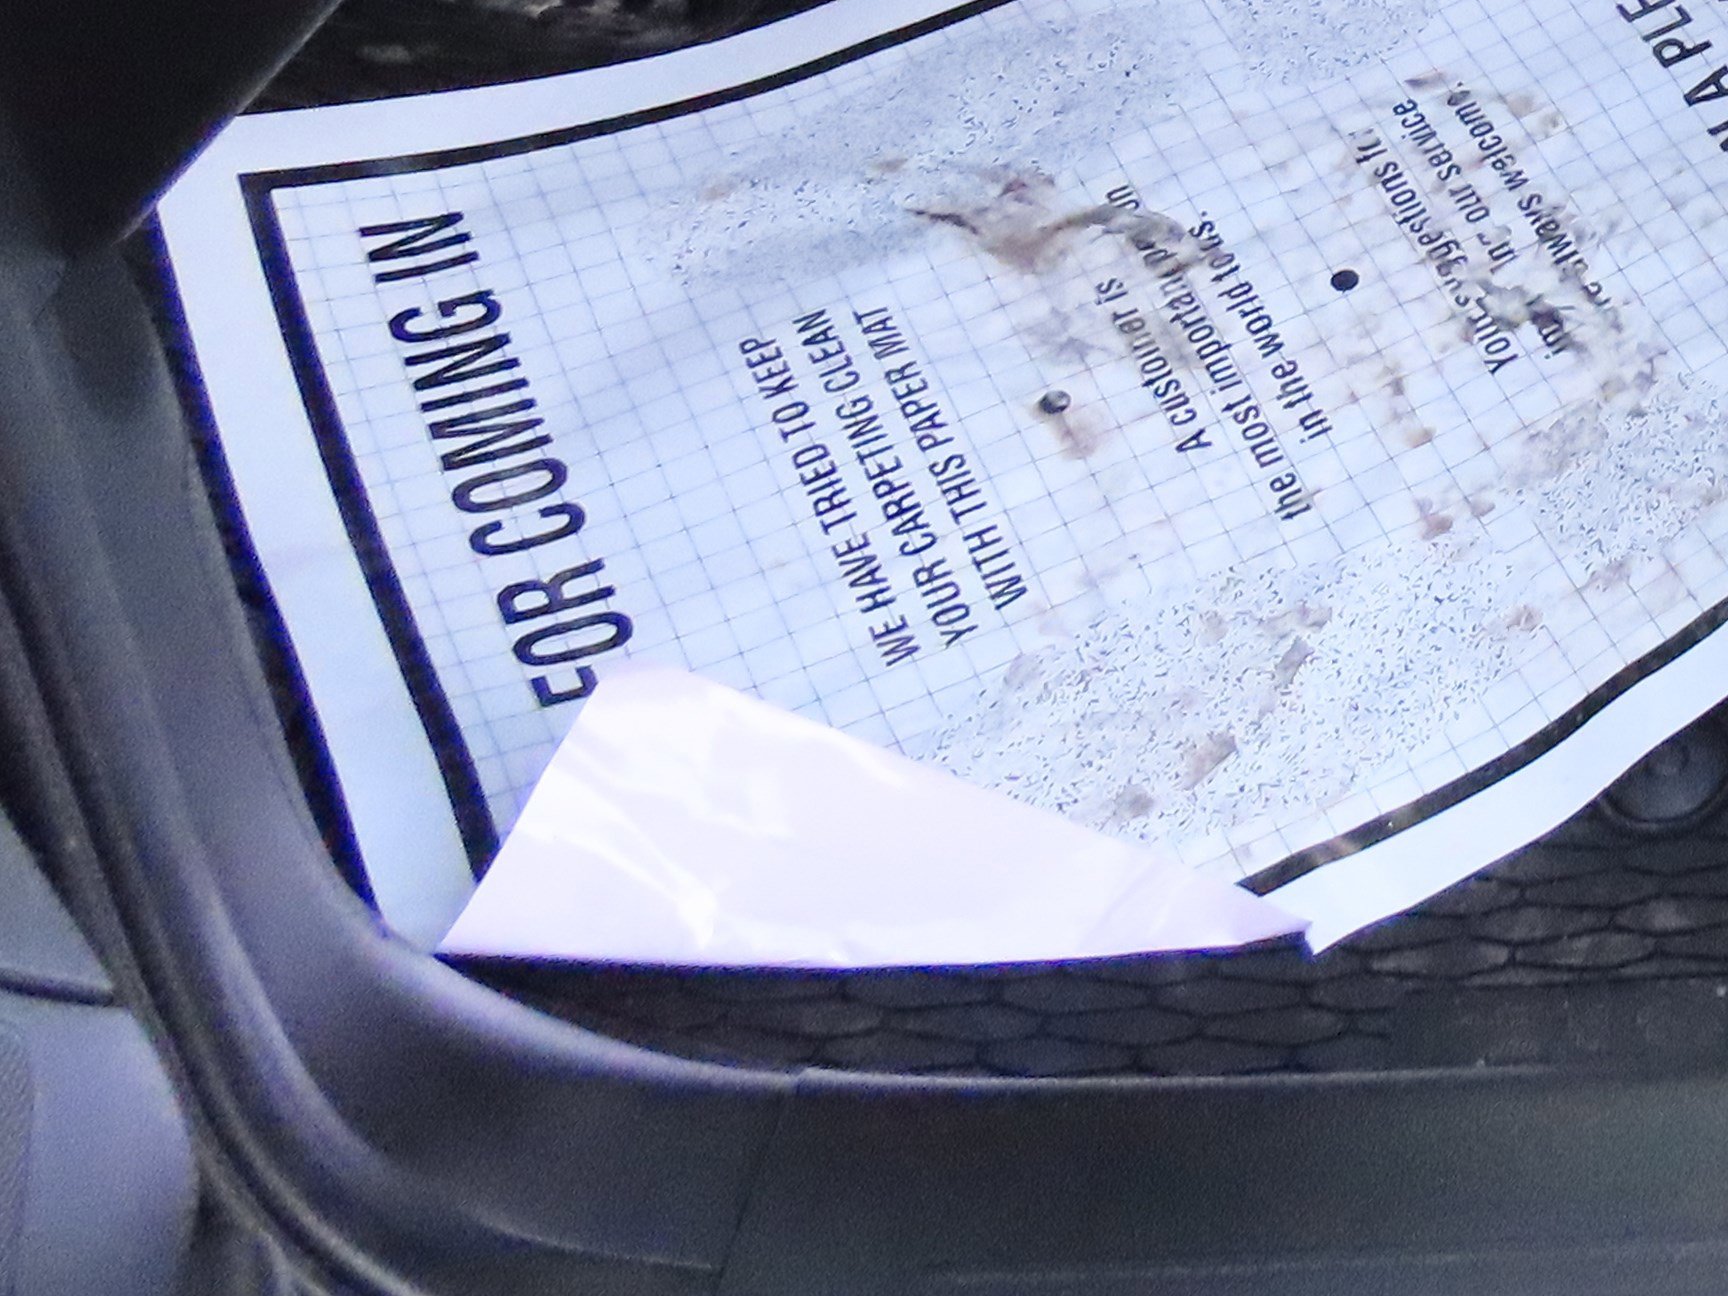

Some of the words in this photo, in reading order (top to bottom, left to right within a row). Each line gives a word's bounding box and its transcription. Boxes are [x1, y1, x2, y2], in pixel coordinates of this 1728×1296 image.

[1393, 99, 1460, 181] service
[1430, 80, 1535, 192] welcome.
[1449, 184, 1488, 222] our
[358, 212, 477, 282] IN
[1199, 251, 1244, 282] to
[1096, 279, 1126, 304] is
[1218, 282, 1283, 357] world
[740, 339, 796, 398] KEEP
[793, 310, 858, 391] CLEAN
[854, 308, 907, 358] MAT
[1101, 303, 1202, 430] customer
[772, 402, 814, 439] TO
[885, 362, 952, 451] PAPER
[1271, 361, 1311, 408] the
[388, 290, 584, 555] COMING
[1176, 429, 1210, 451] A
[1222, 395, 1282, 467] most
[1299, 410, 1331, 438] in
[793, 444, 855, 533] TRIED
[836, 396, 936, 555] CARPETING
[929, 455, 985, 523] THIS
[1256, 469, 1319, 522] the
[832, 534, 894, 612] HAVE
[913, 559, 976, 645] YOUR
[964, 526, 1026, 609] WITH
[497, 559, 631, 706] FOR
[871, 617, 918, 665] WE
